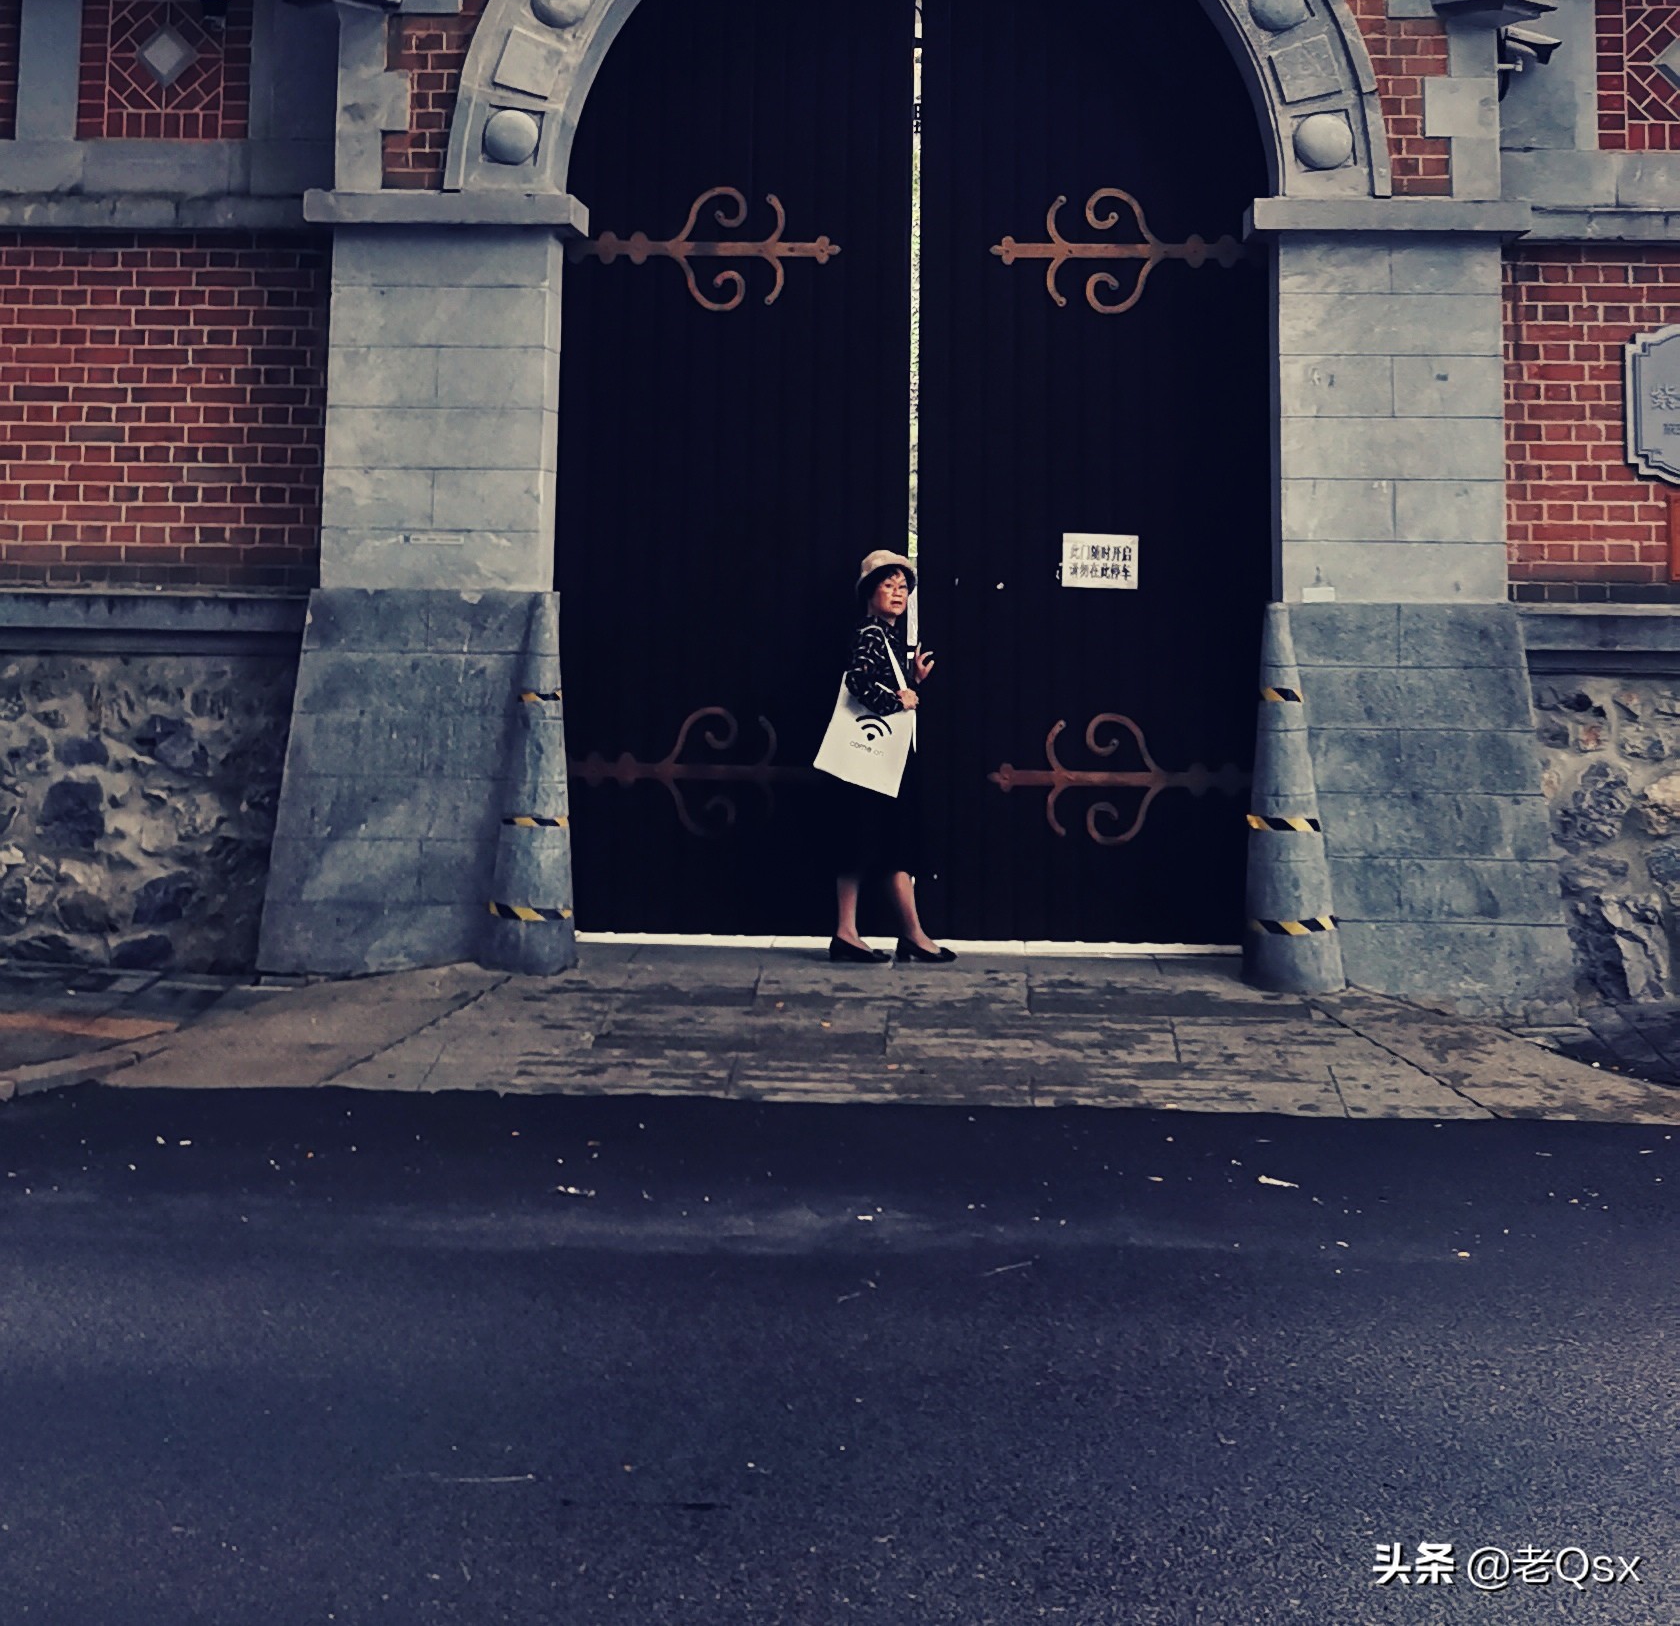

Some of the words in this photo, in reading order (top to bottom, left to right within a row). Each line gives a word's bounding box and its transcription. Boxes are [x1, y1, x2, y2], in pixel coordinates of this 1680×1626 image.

[1069, 560, 1132, 580] 请勿在此停车
